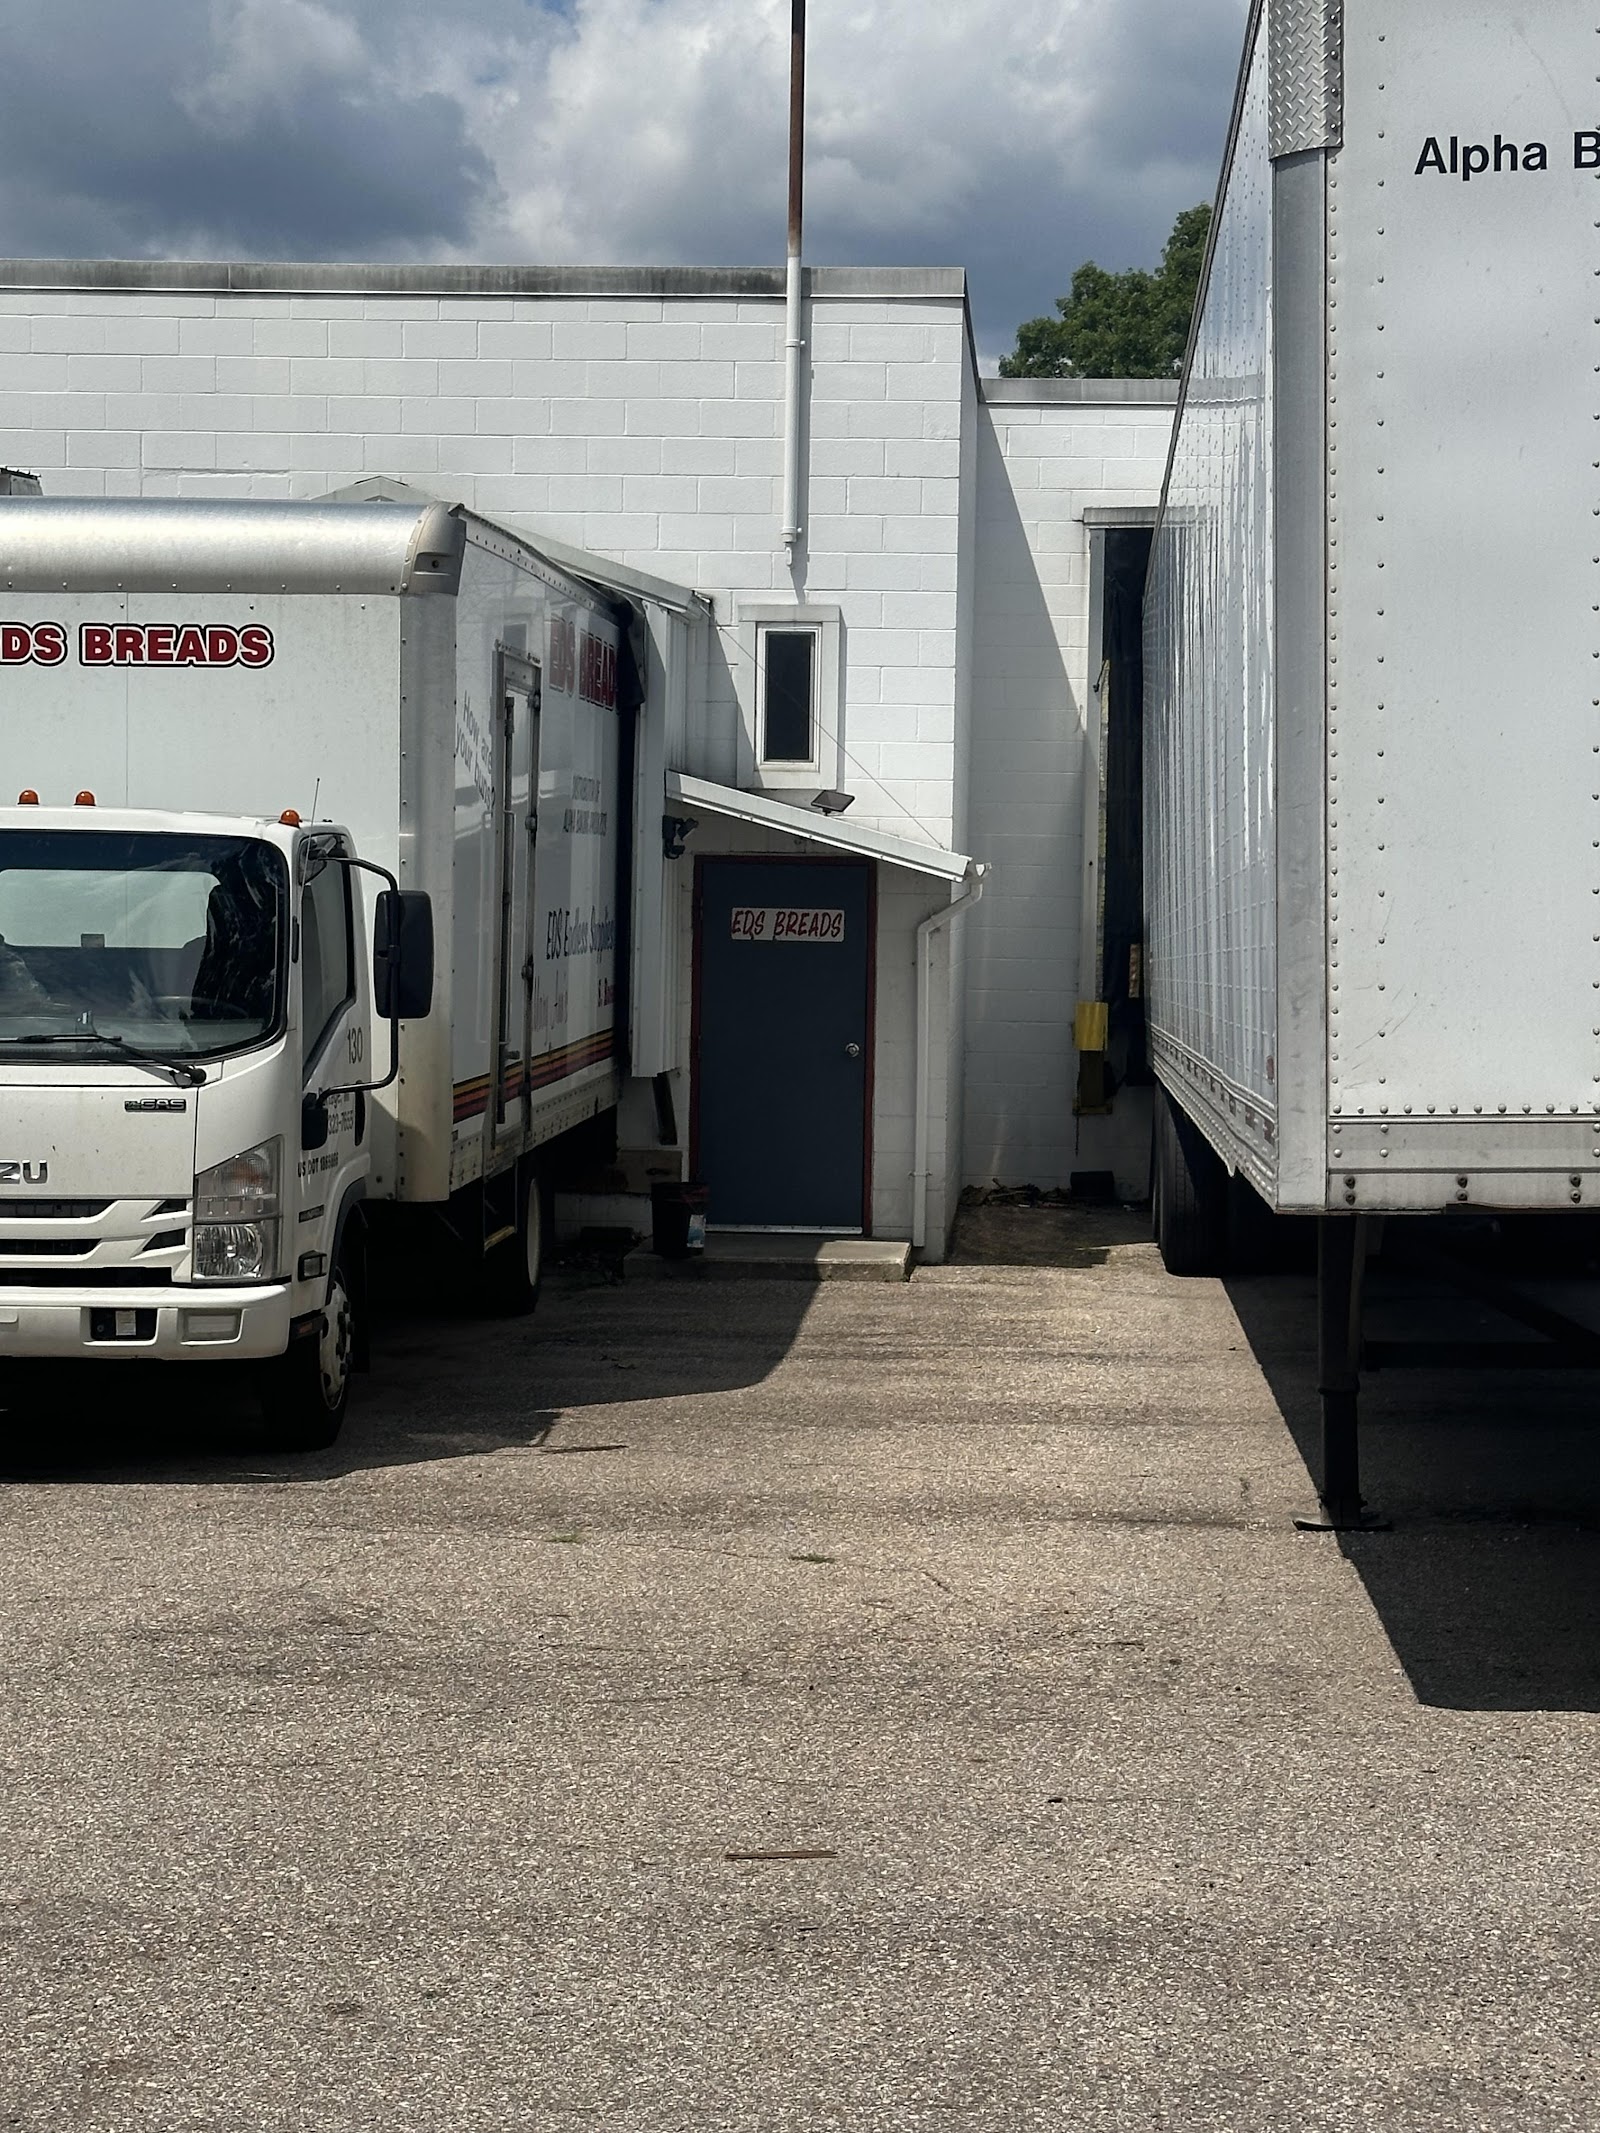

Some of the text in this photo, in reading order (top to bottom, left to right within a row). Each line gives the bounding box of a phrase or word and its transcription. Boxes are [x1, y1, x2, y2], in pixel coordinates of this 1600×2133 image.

[1414, 134, 1547, 181] Alpha
[78, 622, 275, 669] BREADS
[549, 611, 618, 712] EDS BREAD
[463, 689, 480, 746] How
[456, 722, 473, 772] your
[546, 907, 562, 960] EDS
[774, 910, 842, 938] BREADS
[348, 1027, 363, 1065] 130
[297, 1160, 306, 1178] US
